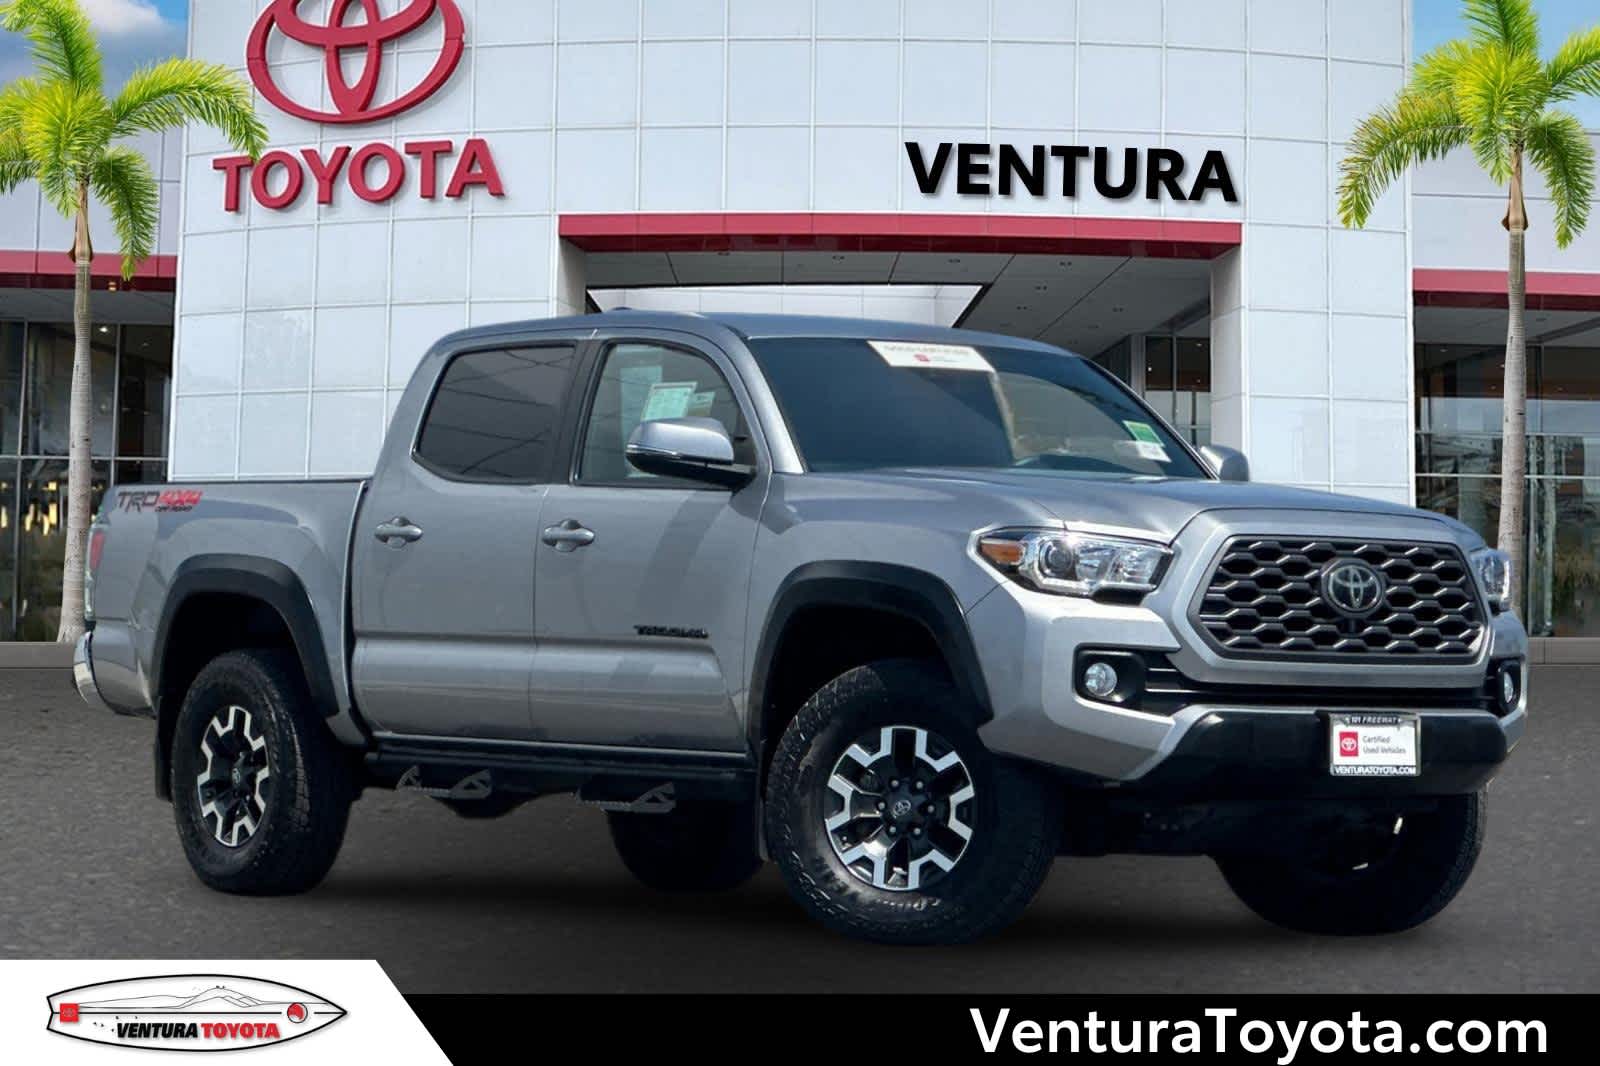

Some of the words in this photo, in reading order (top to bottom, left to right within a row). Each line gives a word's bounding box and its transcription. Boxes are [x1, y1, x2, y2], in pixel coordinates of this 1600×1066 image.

[213, 139, 505, 213] TOYOTA
[905, 142, 1239, 202] VENTURA
[1362, 735, 1391, 744] Certified
[1362, 746, 1380, 754] Used
[1380, 746, 1406, 754] Vehicles
[1334, 766, 1416, 775] VENTURATOYOTA.COM
